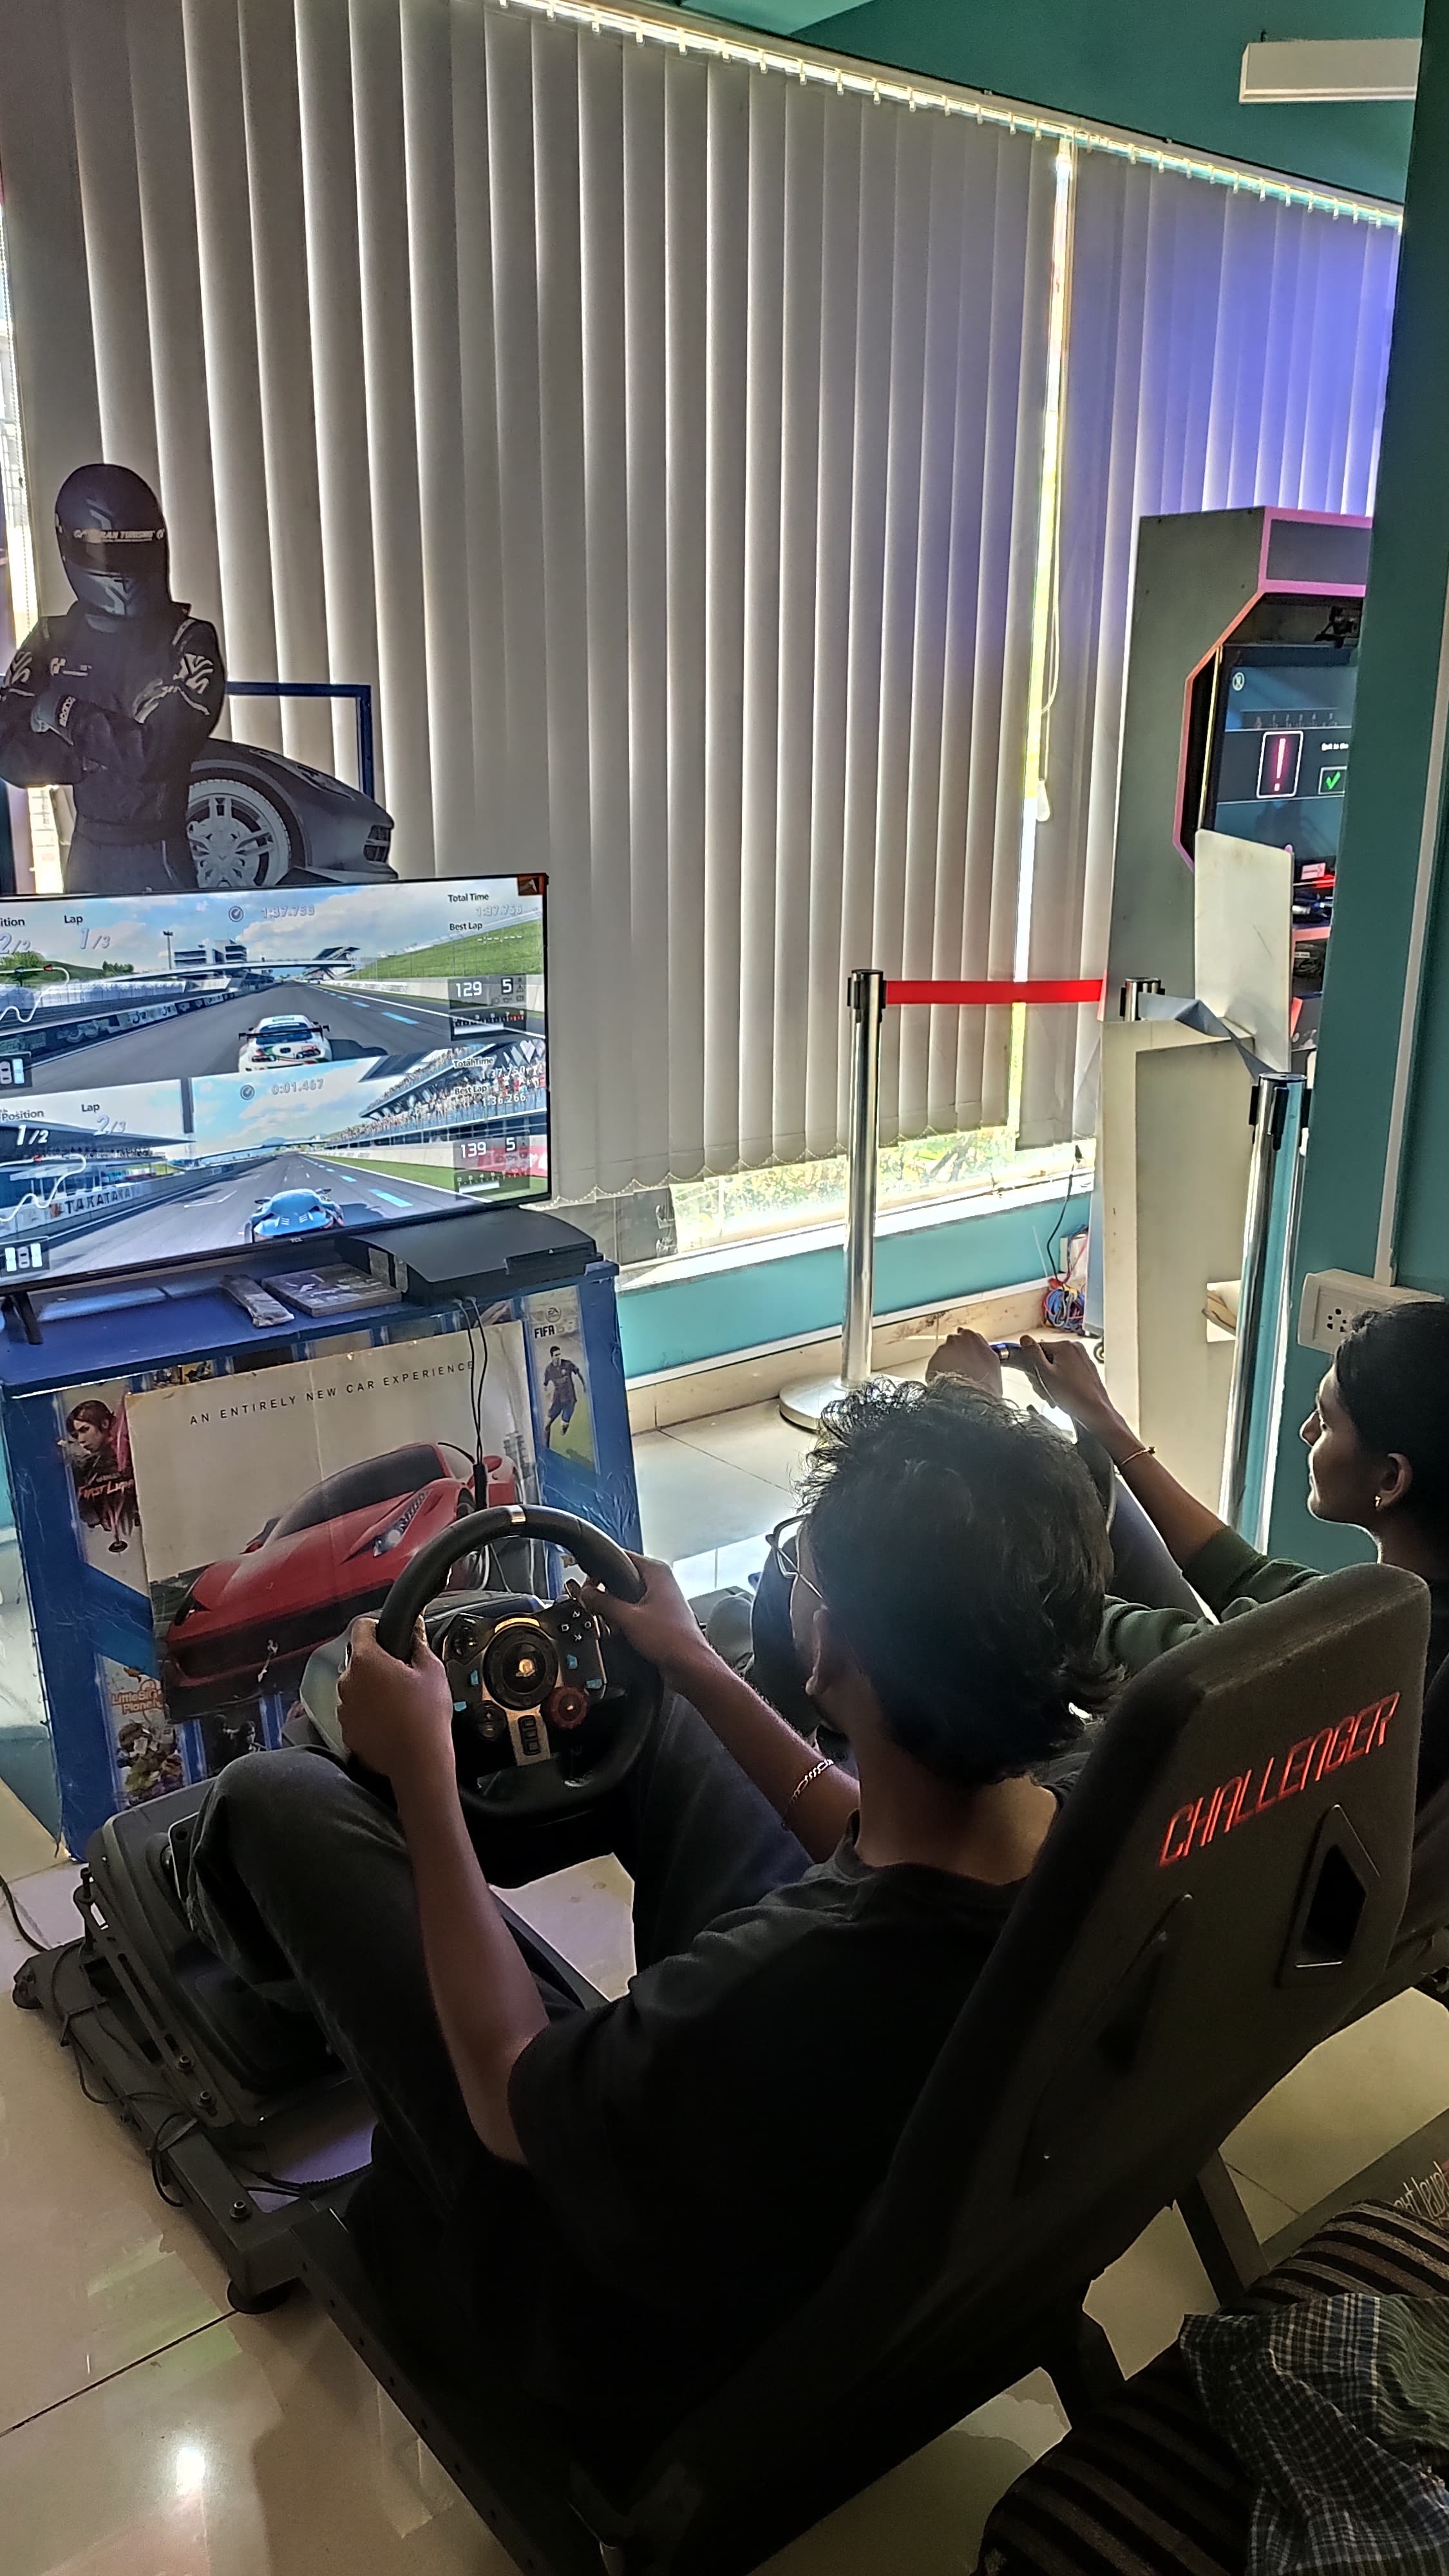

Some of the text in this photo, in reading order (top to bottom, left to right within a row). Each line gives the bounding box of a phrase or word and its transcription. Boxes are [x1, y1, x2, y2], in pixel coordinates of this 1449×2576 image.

[448, 893, 468, 902] Total
[0, 918, 26, 927] ition
[64, 914, 83, 925] Lap
[449, 922, 483, 931] Best Lap
[455, 978, 513, 998] 129 5
[453, 1057, 494, 1068] Total Time
[473, 1085, 487, 1094] Lap
[81, 1103, 100, 1113] Lap
[2, 1110, 44, 1121] Position
[506, 1137, 516, 1151] 5
[460, 1141, 487, 1159] 139
[534, 1325, 555, 1339] FIFA
[189, 1361, 473, 1425] AN ENTIRELY NEW CAR EXPERIENCE
[1159, 1691, 1400, 1868] CHALLENGER
